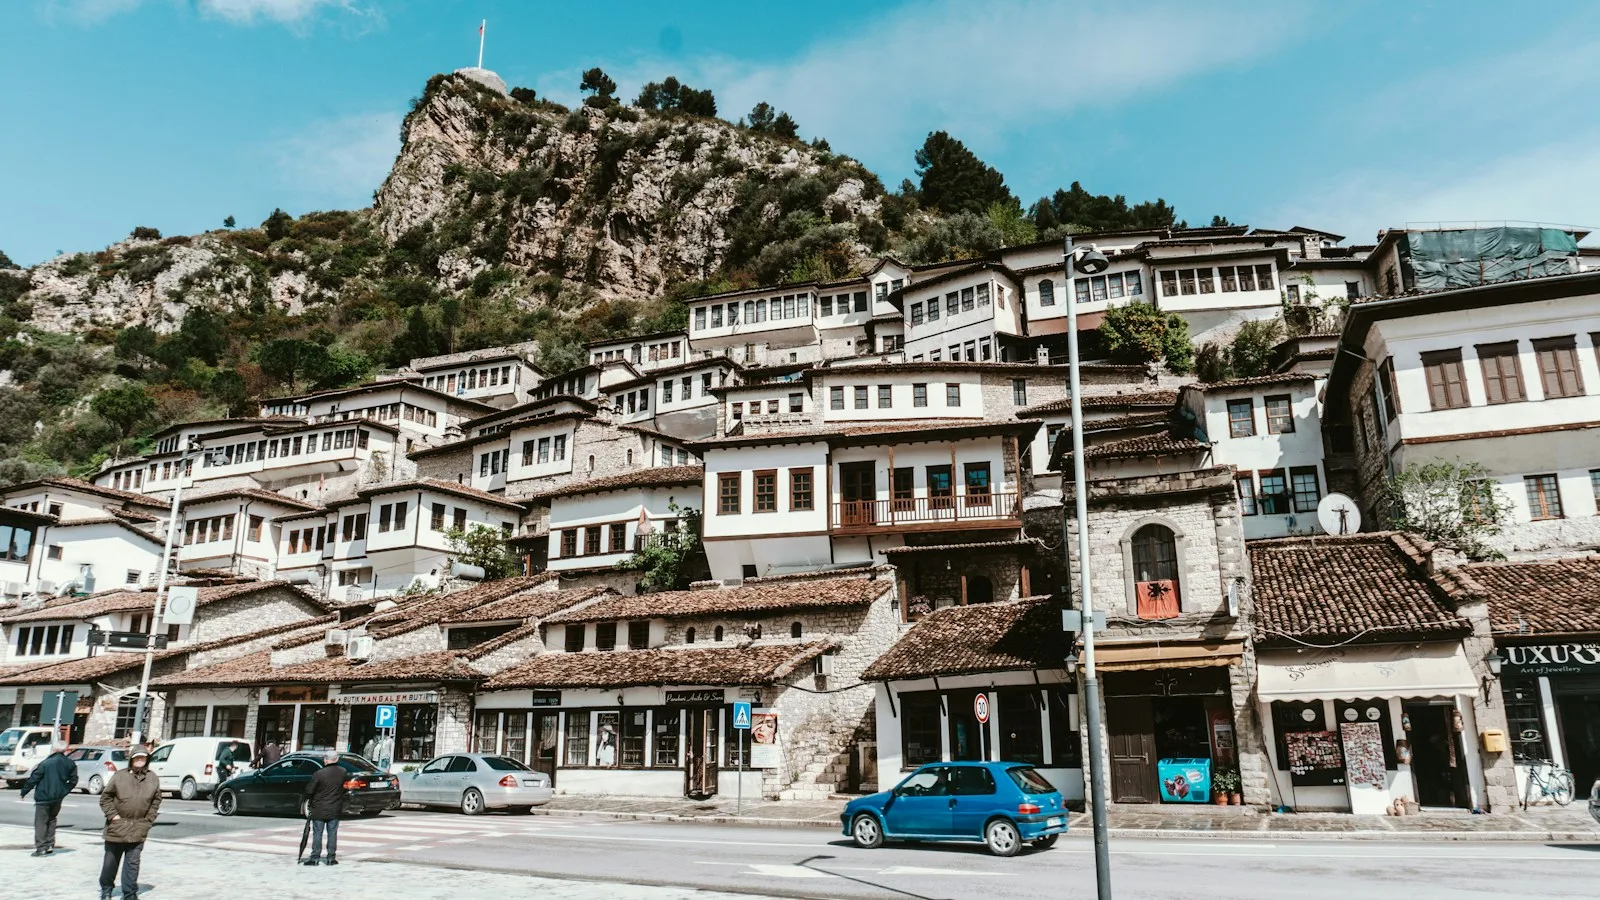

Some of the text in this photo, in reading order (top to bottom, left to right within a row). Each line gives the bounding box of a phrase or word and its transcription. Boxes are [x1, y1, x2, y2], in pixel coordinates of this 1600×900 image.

[1502, 644, 1600, 664] UXURY
[1545, 666, 1581, 674] Jewellery
[361, 695, 407, 703] MANGALEM
[703, 693, 710, 701] &
[978, 702, 985, 714] 30
[379, 708, 391, 725] P
